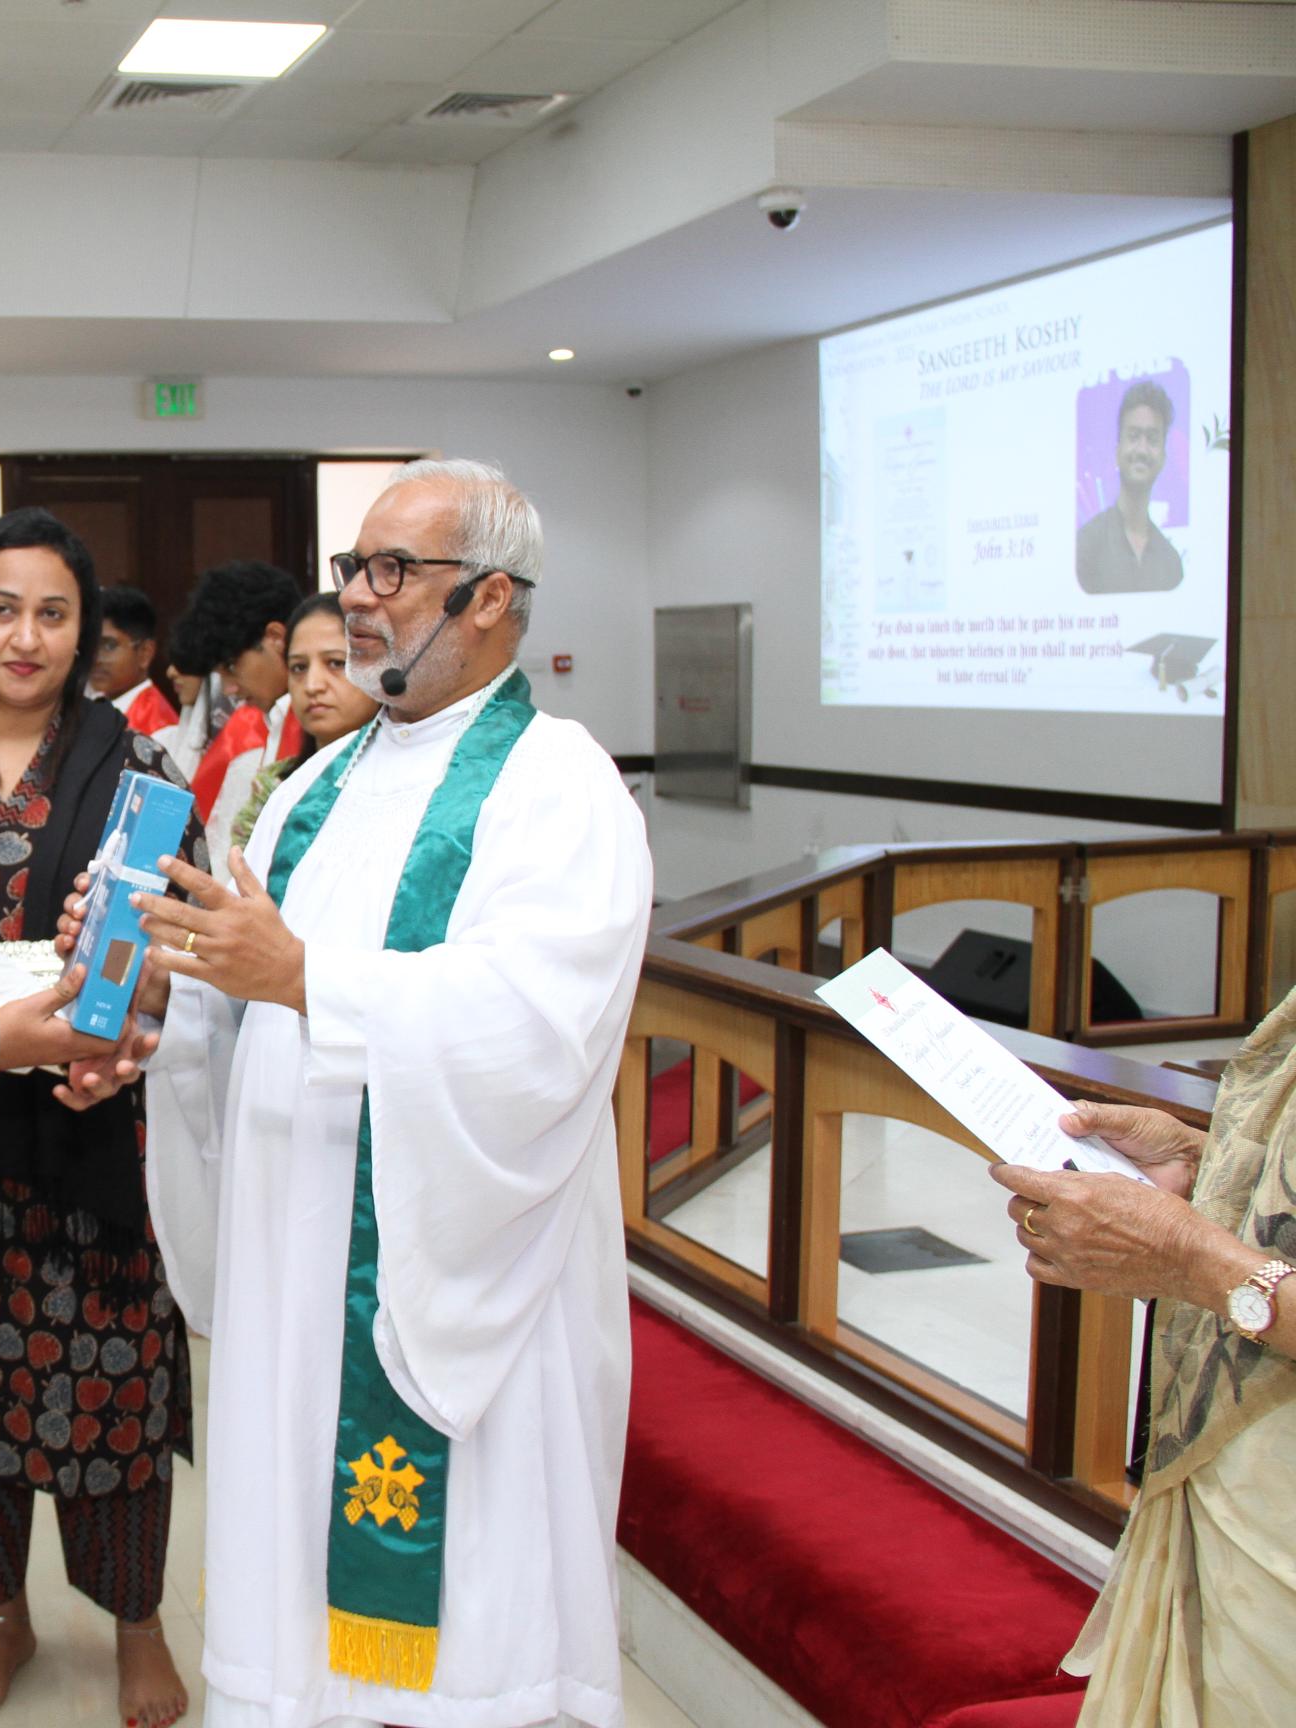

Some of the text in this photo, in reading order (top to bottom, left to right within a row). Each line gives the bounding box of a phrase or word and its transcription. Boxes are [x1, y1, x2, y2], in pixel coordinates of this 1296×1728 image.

[917, 332, 1007, 376] SANGEETH
[1015, 314, 1081, 353] KOSHY
[919, 349, 1082, 400] THE LORD IS MY SAVIOUR
[971, 536, 1035, 567] John 3:16
